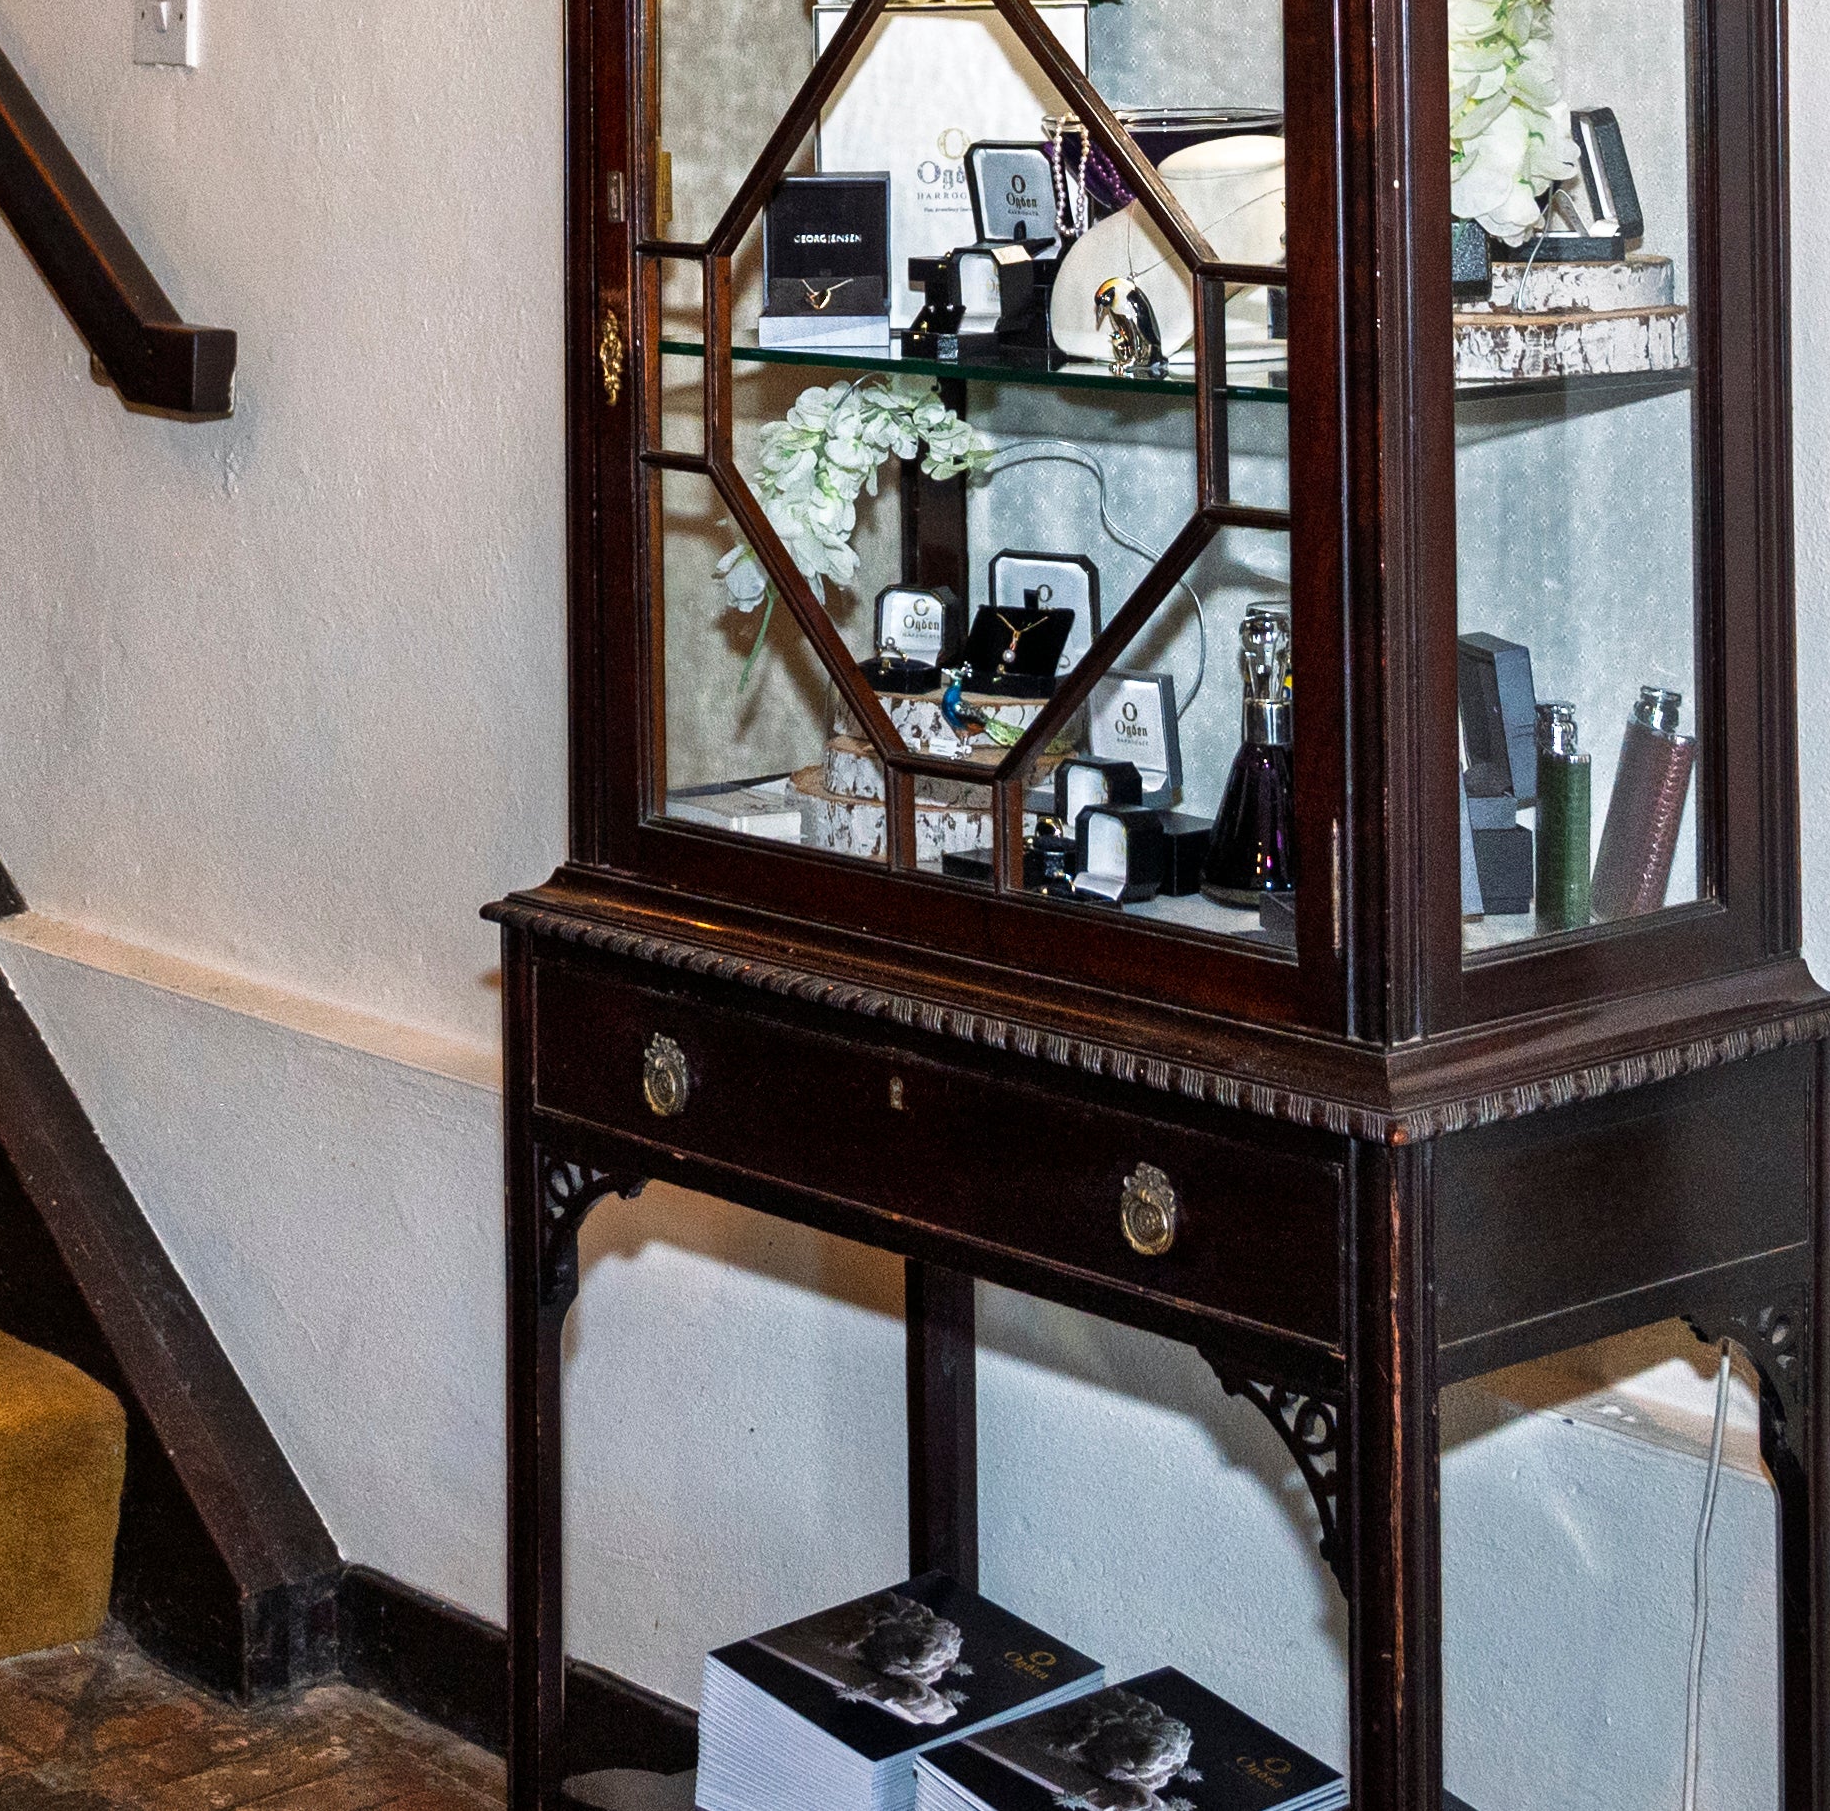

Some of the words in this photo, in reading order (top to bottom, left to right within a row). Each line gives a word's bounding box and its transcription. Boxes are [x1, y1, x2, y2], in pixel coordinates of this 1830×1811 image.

[1005, 192, 1037, 210] Ogden
[794, 234, 827, 244] GEORG
[903, 615, 940, 632] Ogden
[1115, 720, 1148, 738] Ogden
